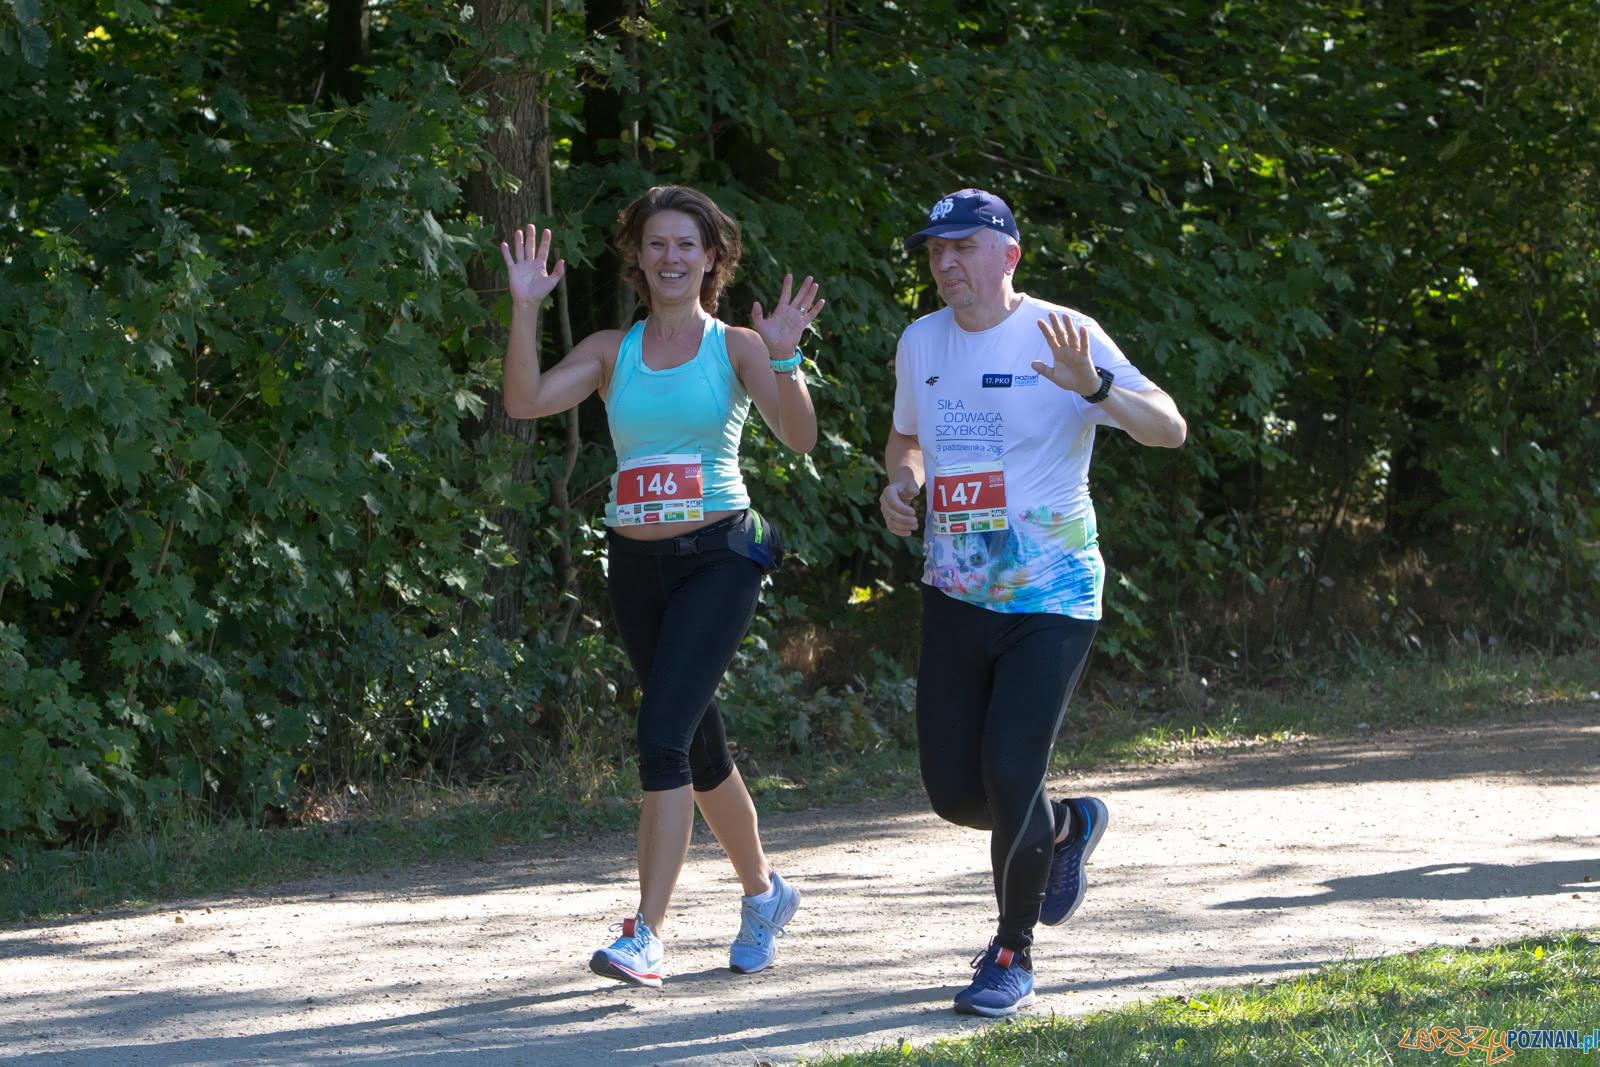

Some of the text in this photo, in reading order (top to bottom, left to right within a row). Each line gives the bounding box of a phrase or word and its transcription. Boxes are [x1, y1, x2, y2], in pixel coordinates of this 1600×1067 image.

[925, 376, 939, 386] 4F
[937, 400, 964, 410] SIŁA
[944, 412, 1003, 423] ODWAGA
[936, 424, 1004, 436] SZYBKOŚĆ
[636, 472, 678, 497] 146
[938, 481, 982, 507] 147
